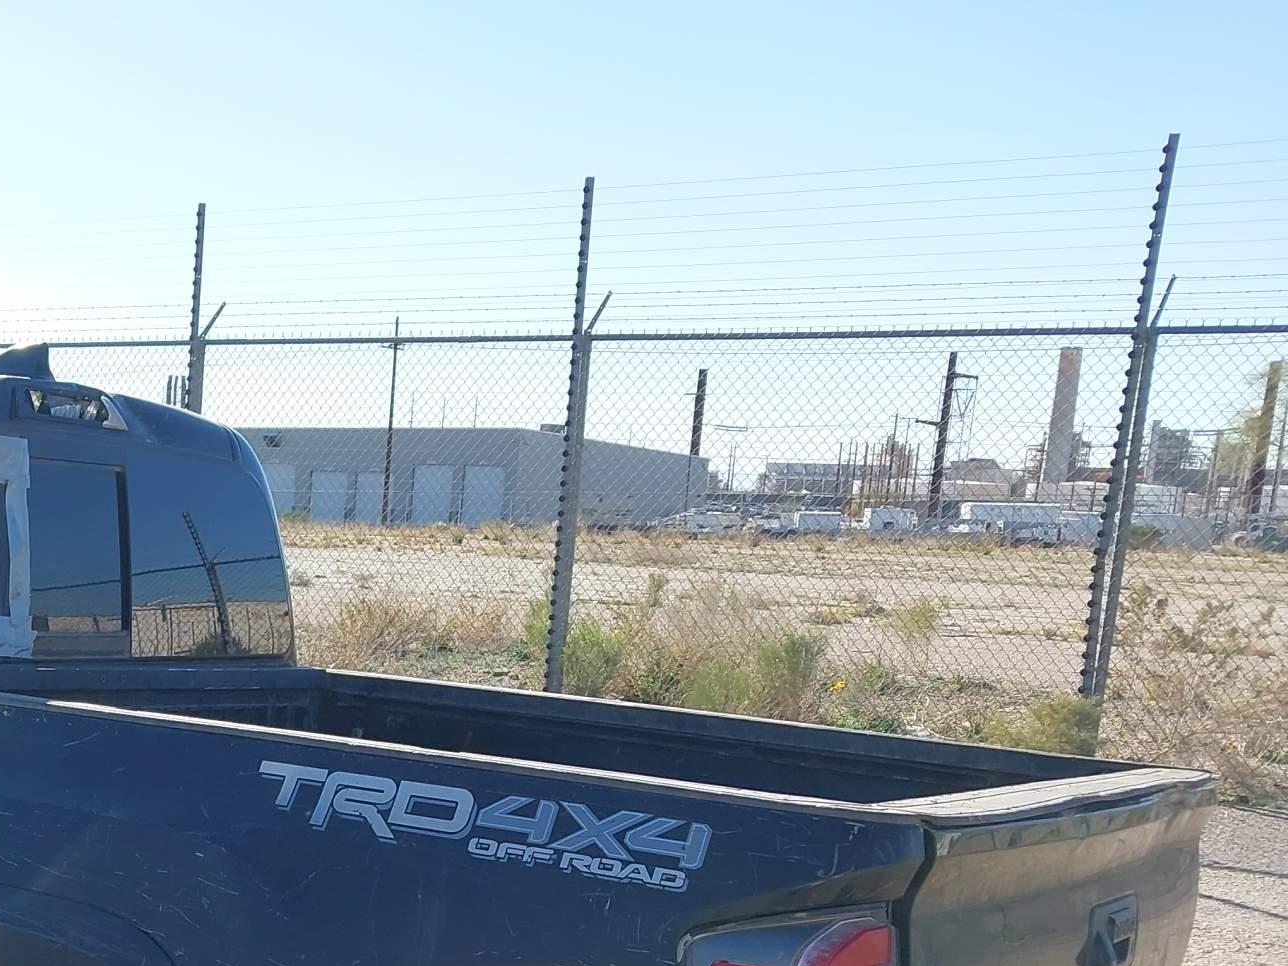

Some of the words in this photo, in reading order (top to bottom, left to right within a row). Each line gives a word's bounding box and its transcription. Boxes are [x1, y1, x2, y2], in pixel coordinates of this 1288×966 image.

[259, 760, 478, 844] TRD
[467, 836, 554, 867] OFF
[559, 851, 690, 893] ROAD
